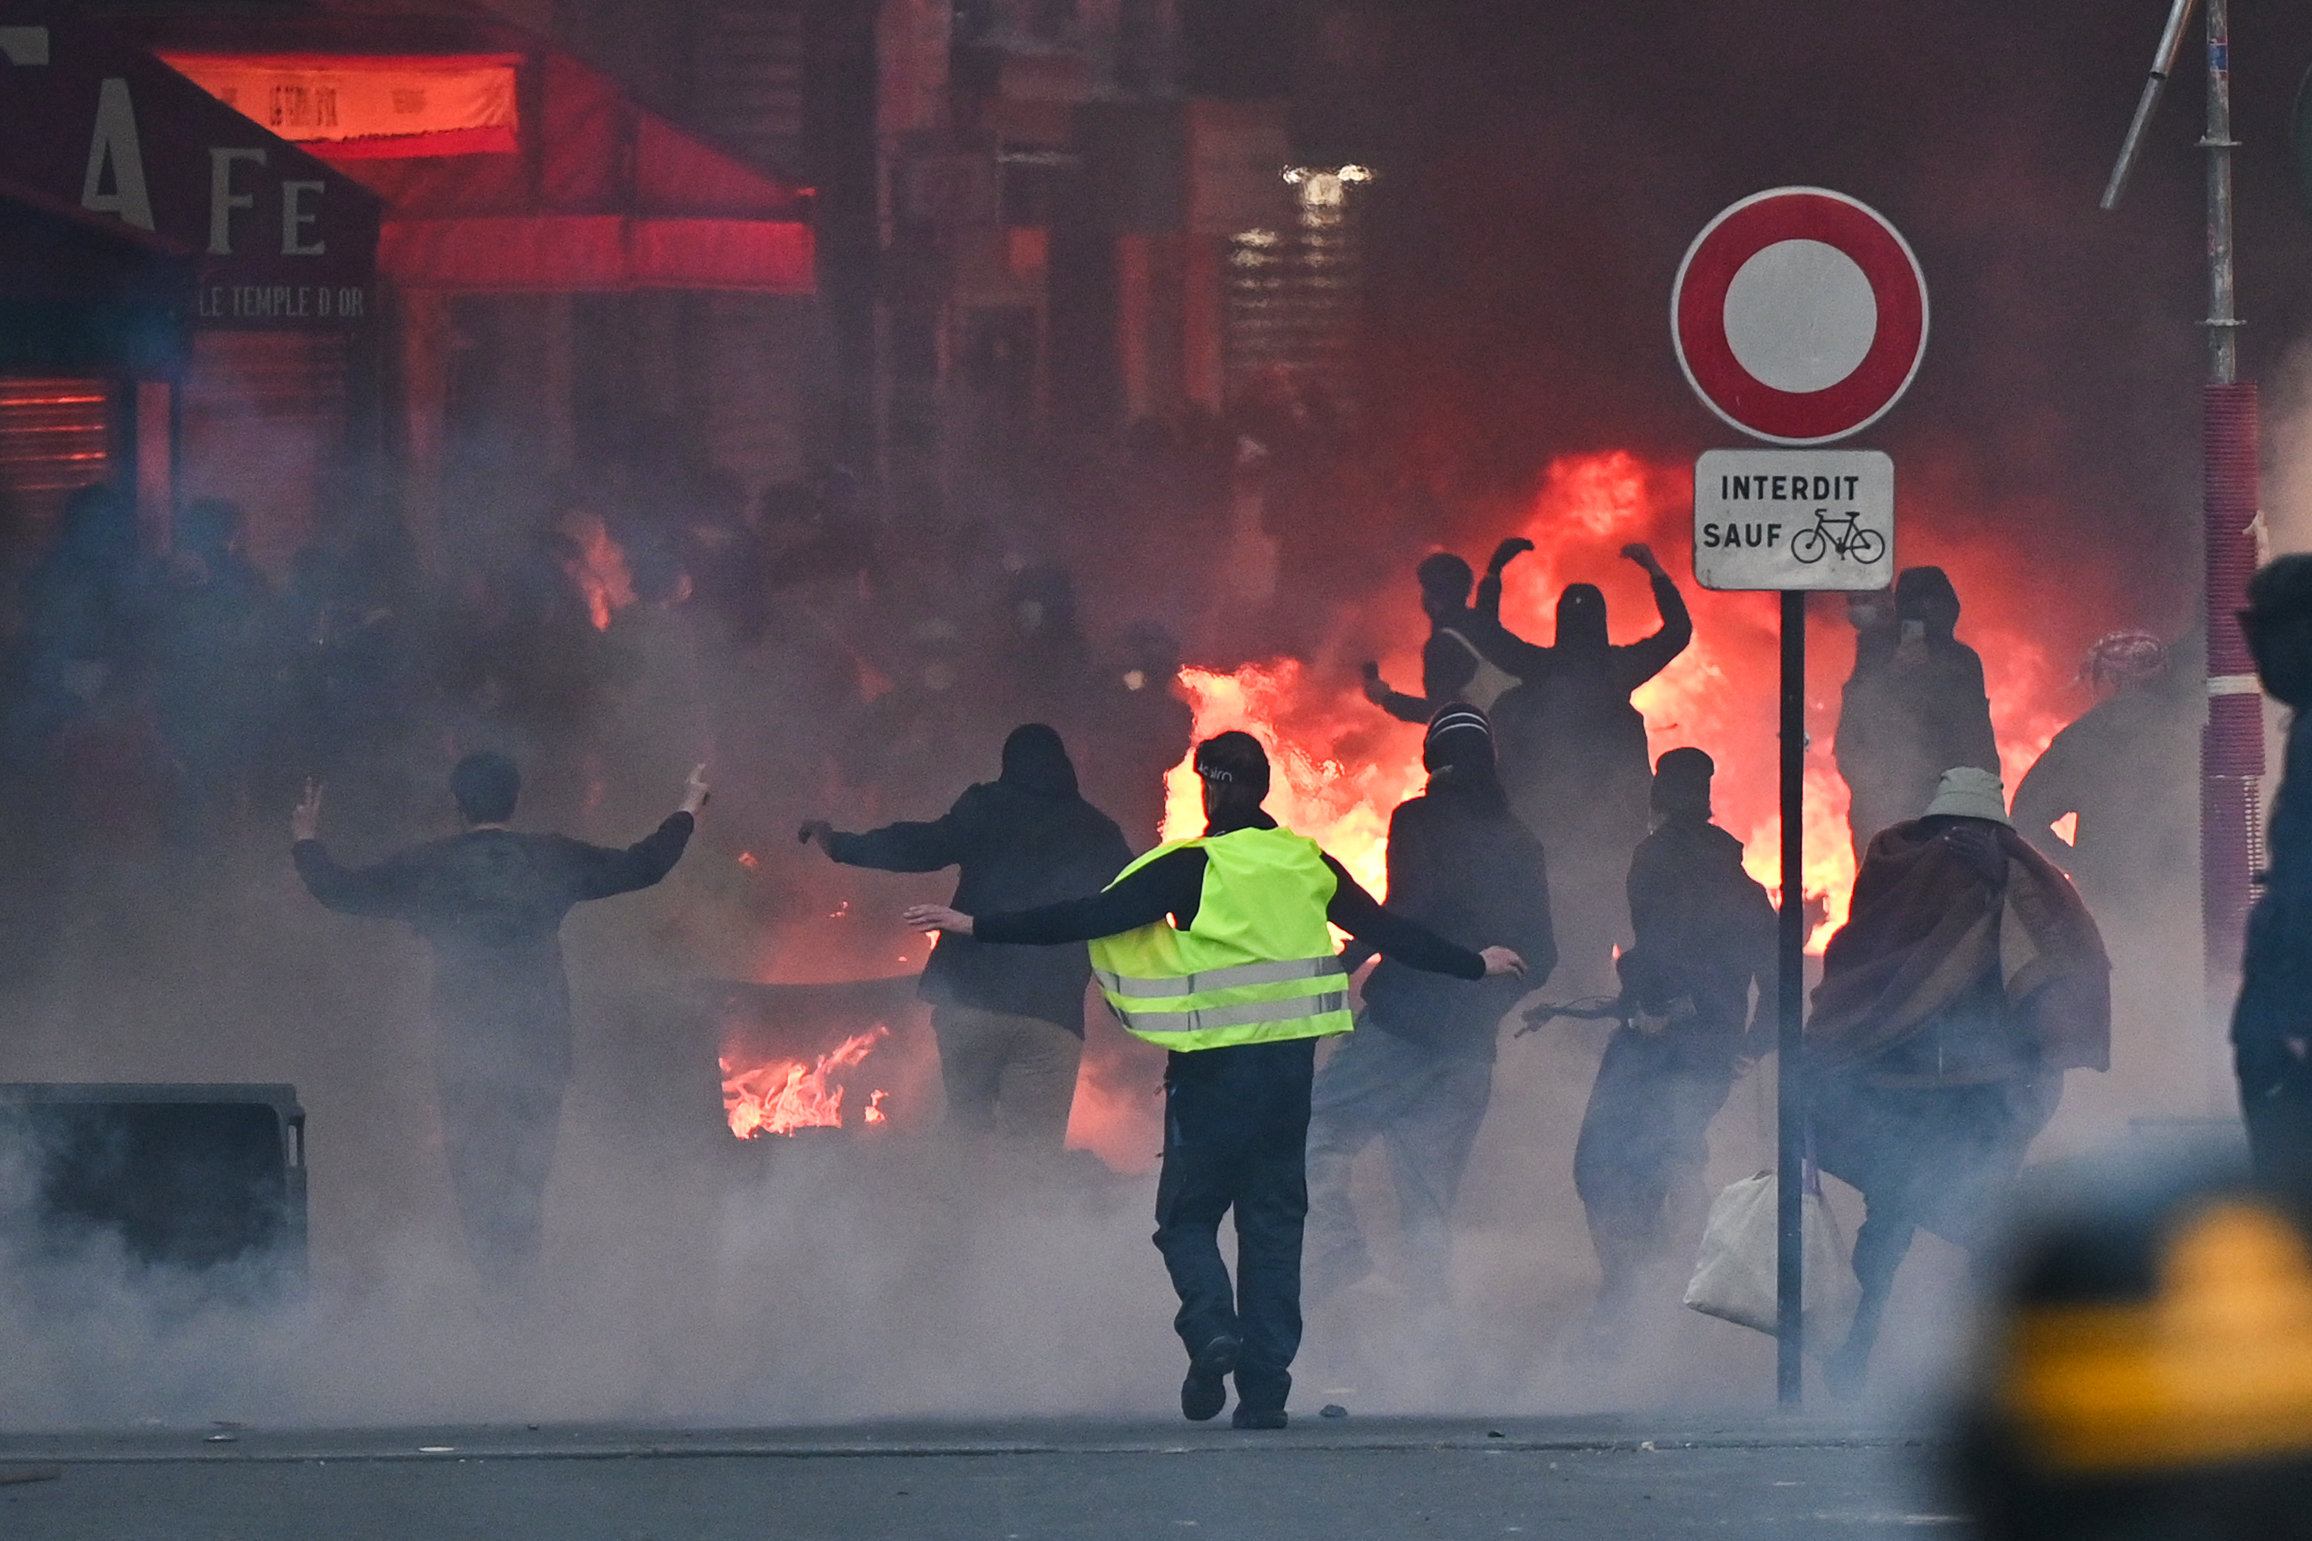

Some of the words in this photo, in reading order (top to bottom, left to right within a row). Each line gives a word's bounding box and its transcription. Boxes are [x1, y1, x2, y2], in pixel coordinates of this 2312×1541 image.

[0, 26, 326, 255] AFE
[200, 286, 222, 315] LE
[232, 286, 310, 315] TEMPLE
[1721, 475, 1859, 500] INTERDIT
[1703, 523, 1782, 548] SAUF
